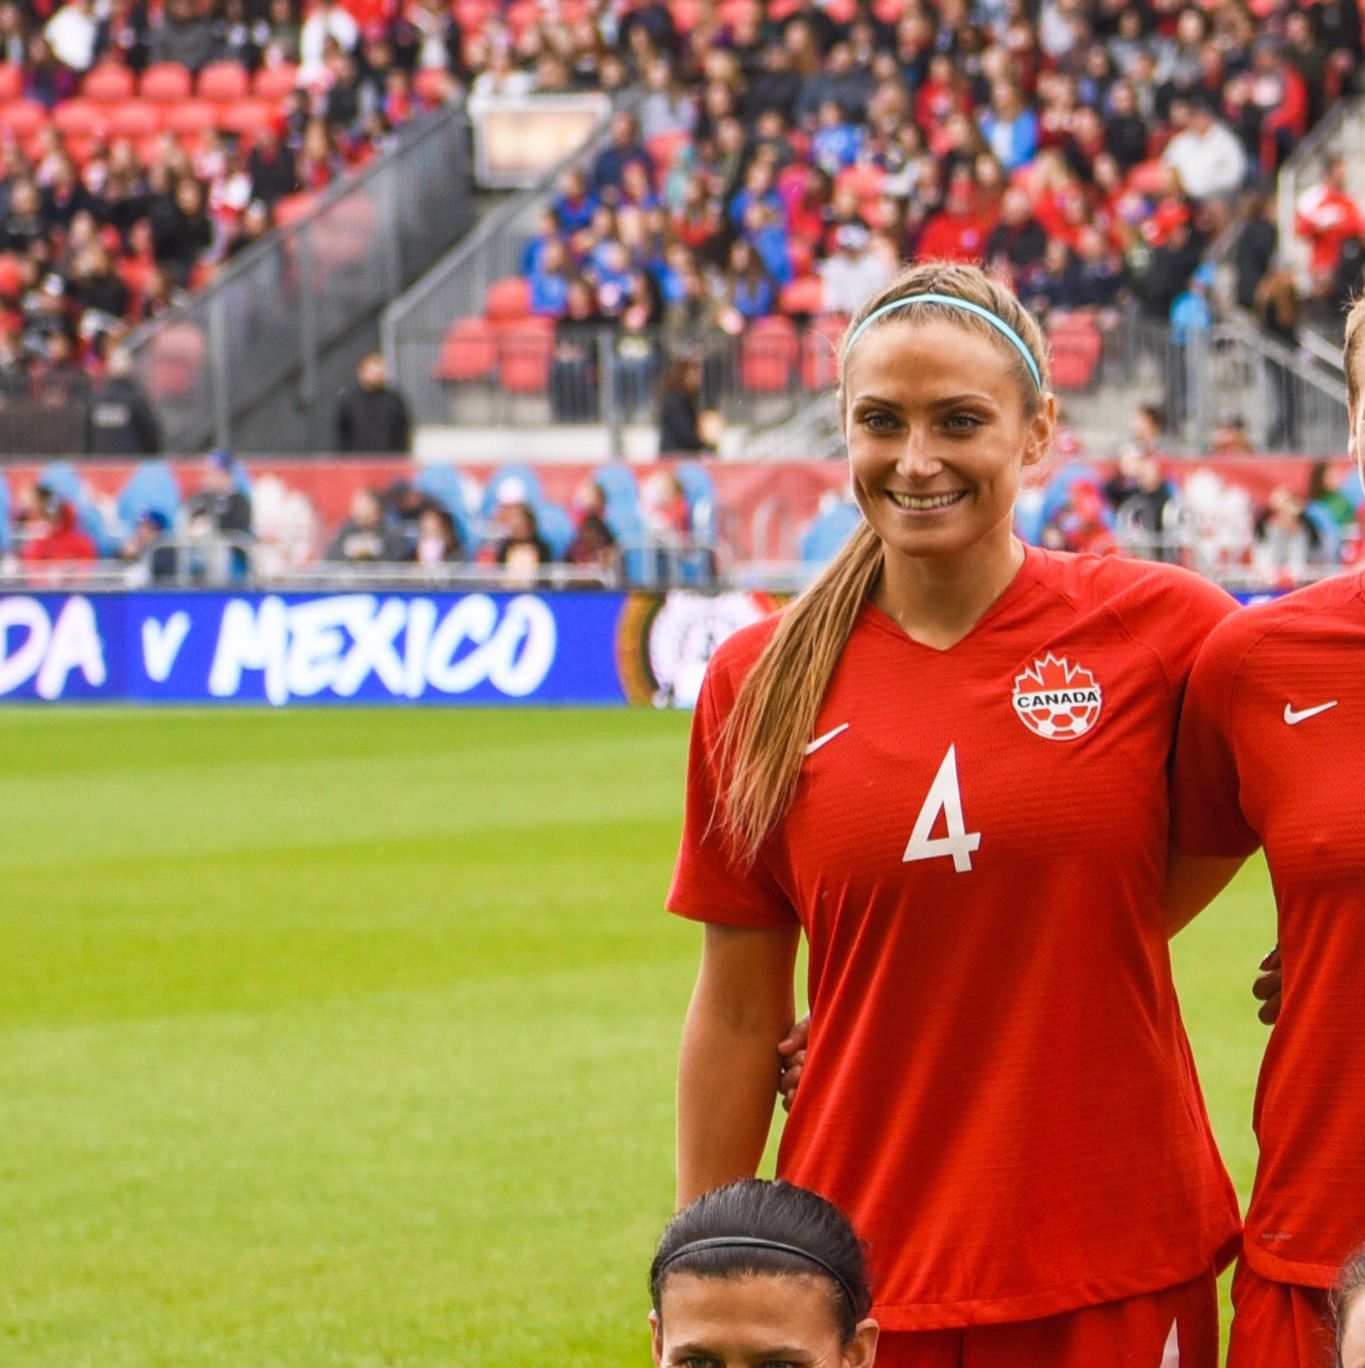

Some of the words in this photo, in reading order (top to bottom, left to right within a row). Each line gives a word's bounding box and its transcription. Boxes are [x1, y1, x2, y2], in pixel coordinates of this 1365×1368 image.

[208, 593, 557, 707] MEXICO
[1017, 691, 1098, 708] CANADA
[903, 744, 981, 872] 4
